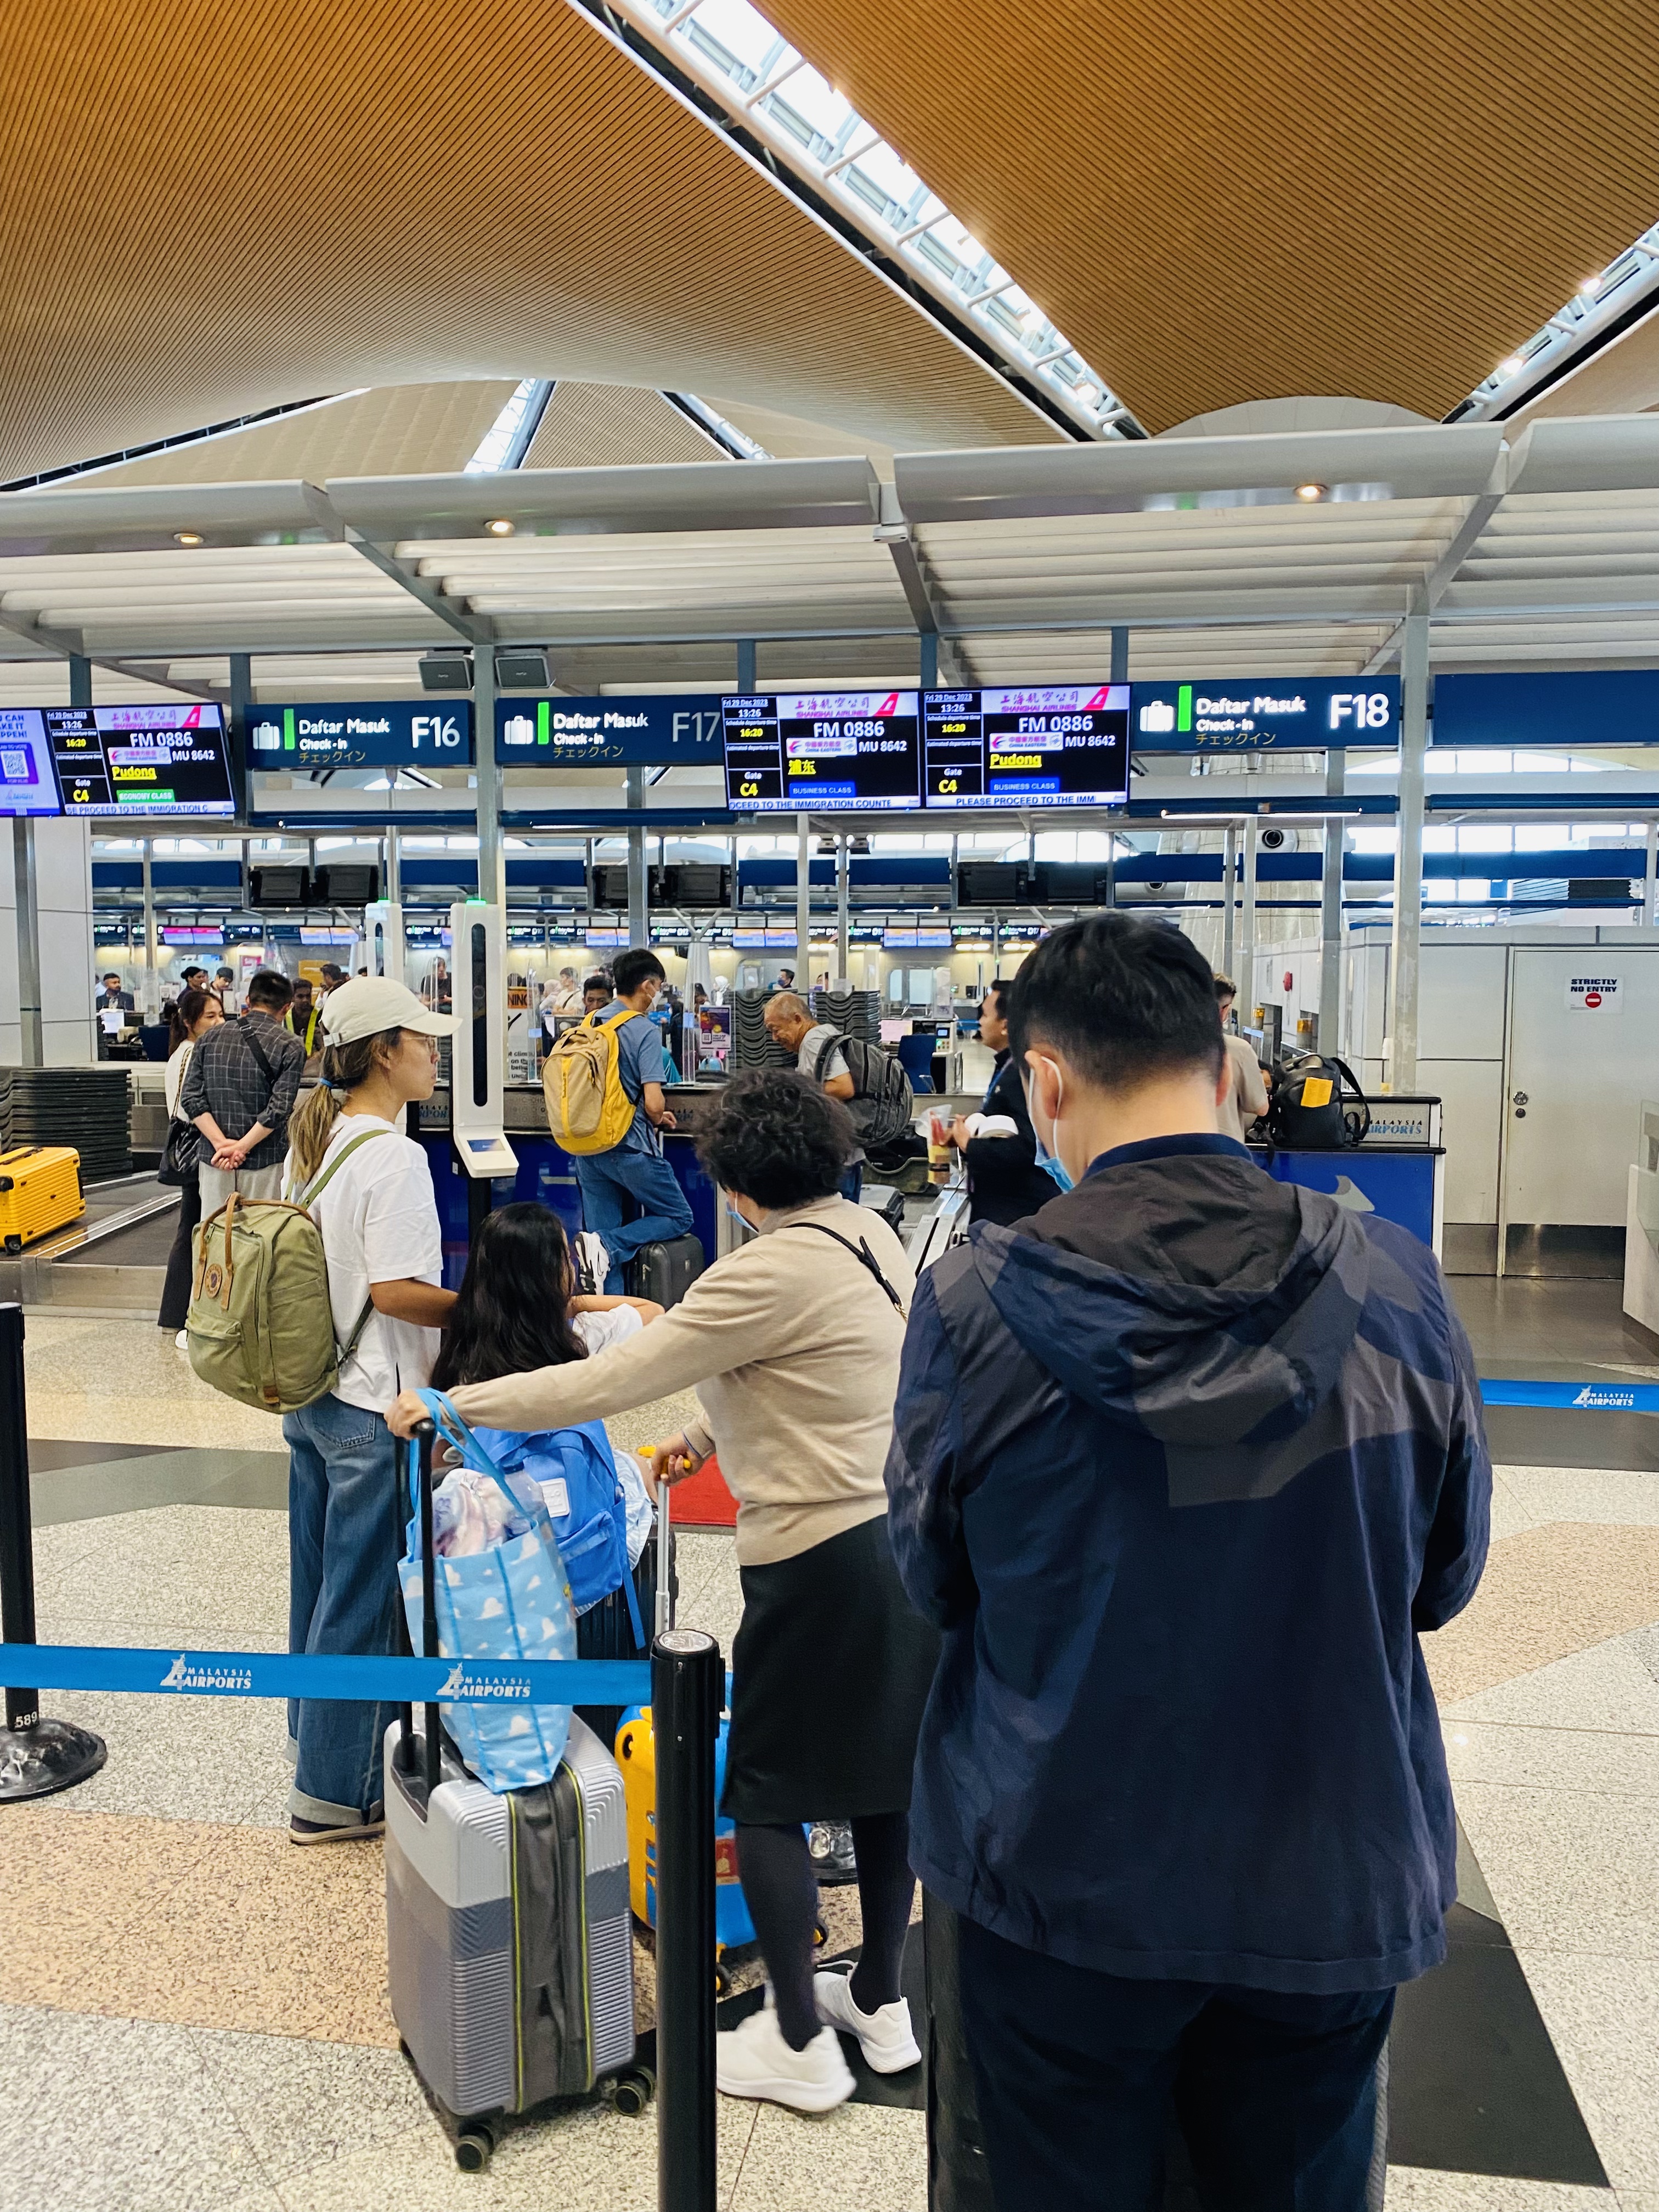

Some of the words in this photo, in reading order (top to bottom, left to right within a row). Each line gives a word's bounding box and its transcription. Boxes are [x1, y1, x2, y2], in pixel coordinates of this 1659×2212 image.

[941, 704, 965, 713] 13:26
[1196, 697, 1250, 715] Daftar
[1254, 696, 1306, 713] Masuk
[1330, 693, 1390, 729] F18
[738, 709, 761, 718] 13:26
[299, 719, 343, 735] Daftar
[347, 718, 390, 734] Masuk
[553, 713, 601, 729] Daftar
[603, 713, 649, 729] Masuk
[672, 712, 720, 742] F17
[1019, 717, 1046, 732] FM
[1050, 715, 1093, 731] 0886
[1196, 719, 1254, 732] Check-in
[411, 716, 460, 748] F16
[740, 728, 763, 737] 16:20
[814, 722, 839, 737] FM
[844, 721, 885, 737] 0886
[942, 724, 966, 732] 16:20
[66, 738, 86, 747] 16:20
[130, 733, 154, 747] FM
[157, 732, 193, 747] 0886
[299, 738, 347, 751] Check-in
[554, 732, 605, 746] Check-in
[1065, 736, 1085, 747] MU
[1087, 735, 1116, 747] 8642
[1195, 732, 1276, 745] チェックイン
[553, 746, 624, 758] チェックイン
[859, 741, 878, 752] MU
[880, 741, 907, 752] 8642
[172, 751, 189, 761] MU
[191, 750, 215, 761] 8642
[298, 751, 366, 763] チェックイン
[990, 753, 1042, 766] Pudong
[111, 766, 156, 778] Pudong
[744, 771, 762, 780] Gate
[944, 768, 962, 776] Gate
[740, 783, 758, 796] C4
[939, 780, 957, 793] C4
[73, 789, 89, 802] C4
[957, 798, 991, 806] PLEASE
[994, 796, 1038, 805] PROCEED
[1041, 796, 1054, 804] TO
[148, 805, 199, 813] IMMIGRATION
[795, 800, 854, 808] IMMIGRATION
[1588, 1398, 1633, 1406] AIRPORTS
[188, 1667, 251, 1677] MALAYSIA
[183, 1675, 251, 1689] AIRPORTS
[465, 1677, 531, 1685] MALAYSIA
[460, 1685, 531, 1697] AIRPORTS
[14, 1711, 37, 1728] 589
